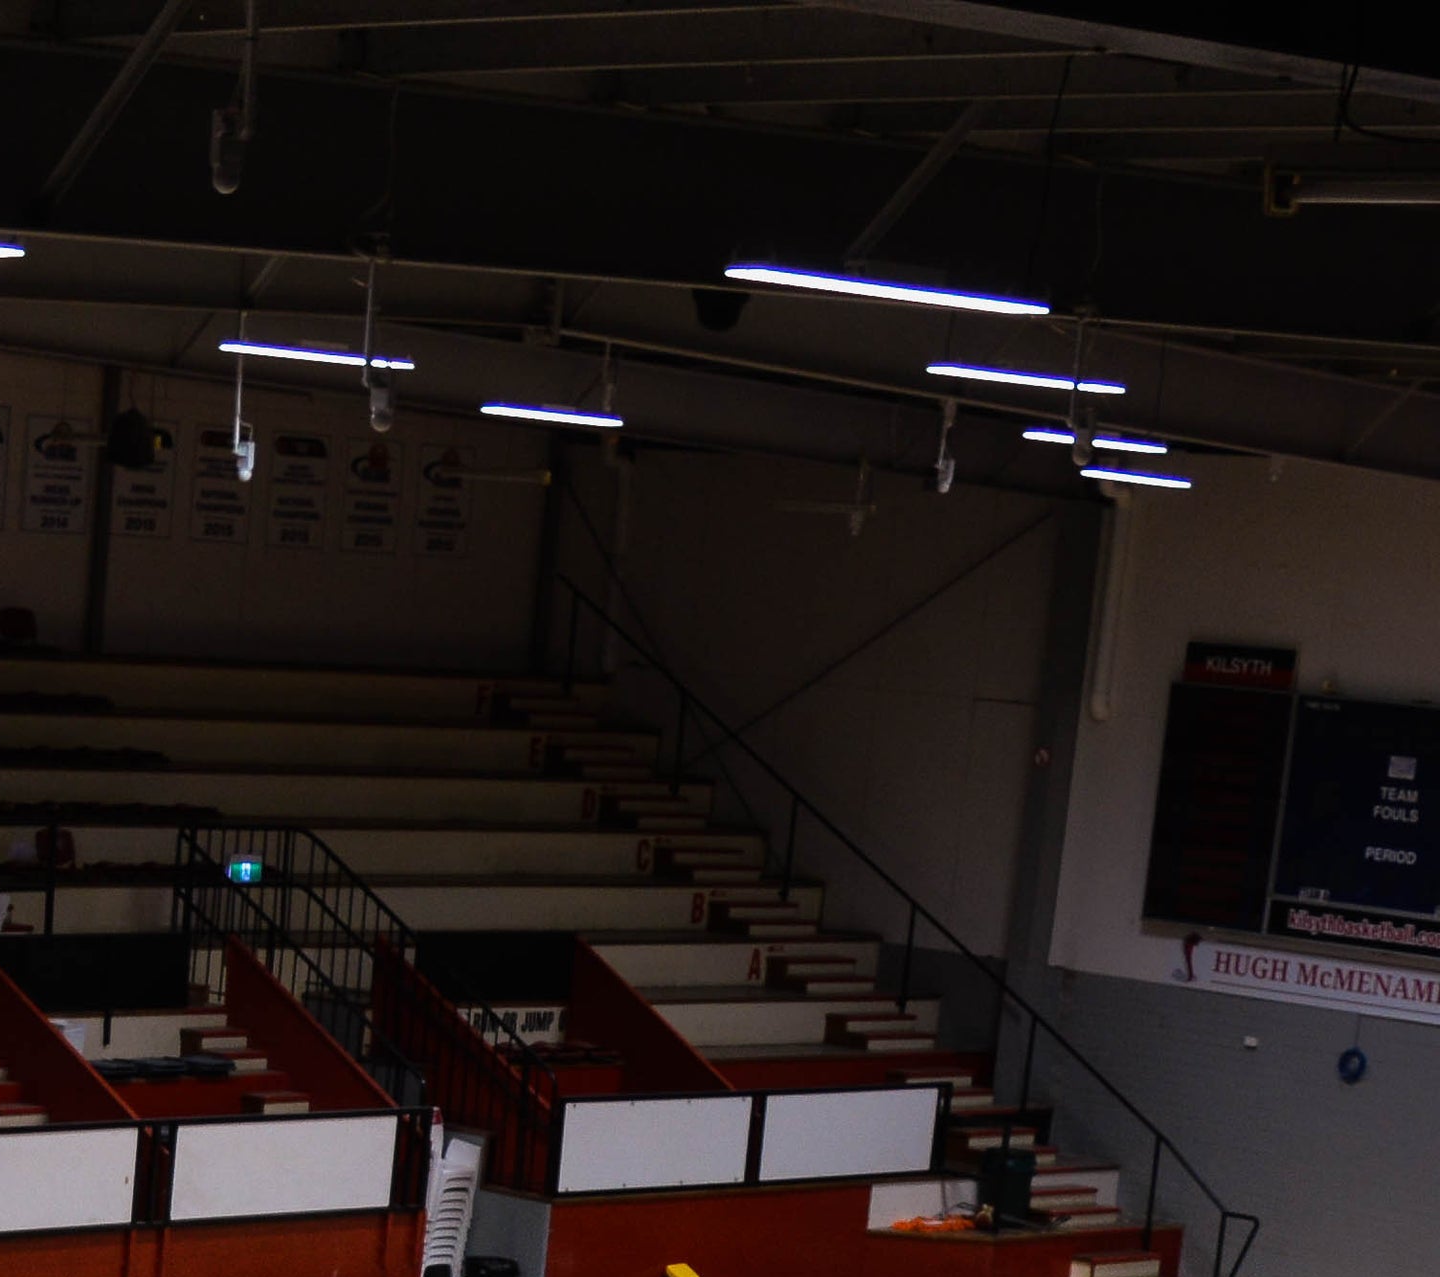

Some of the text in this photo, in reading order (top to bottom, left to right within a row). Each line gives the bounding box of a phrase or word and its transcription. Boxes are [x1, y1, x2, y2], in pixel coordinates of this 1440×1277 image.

[1204, 655, 1273, 677] KILSYTH
[581, 787, 596, 820] D
[1379, 785, 1419, 804] TEAM
[1372, 805, 1420, 824] FOULS
[636, 838, 650, 872] C
[1363, 845, 1418, 866] PERIOD
[691, 892, 704, 924] B
[748, 947, 761, 981] A
[1213, 950, 1289, 983] HUGH
[521, 1010, 555, 1033] JUMP
